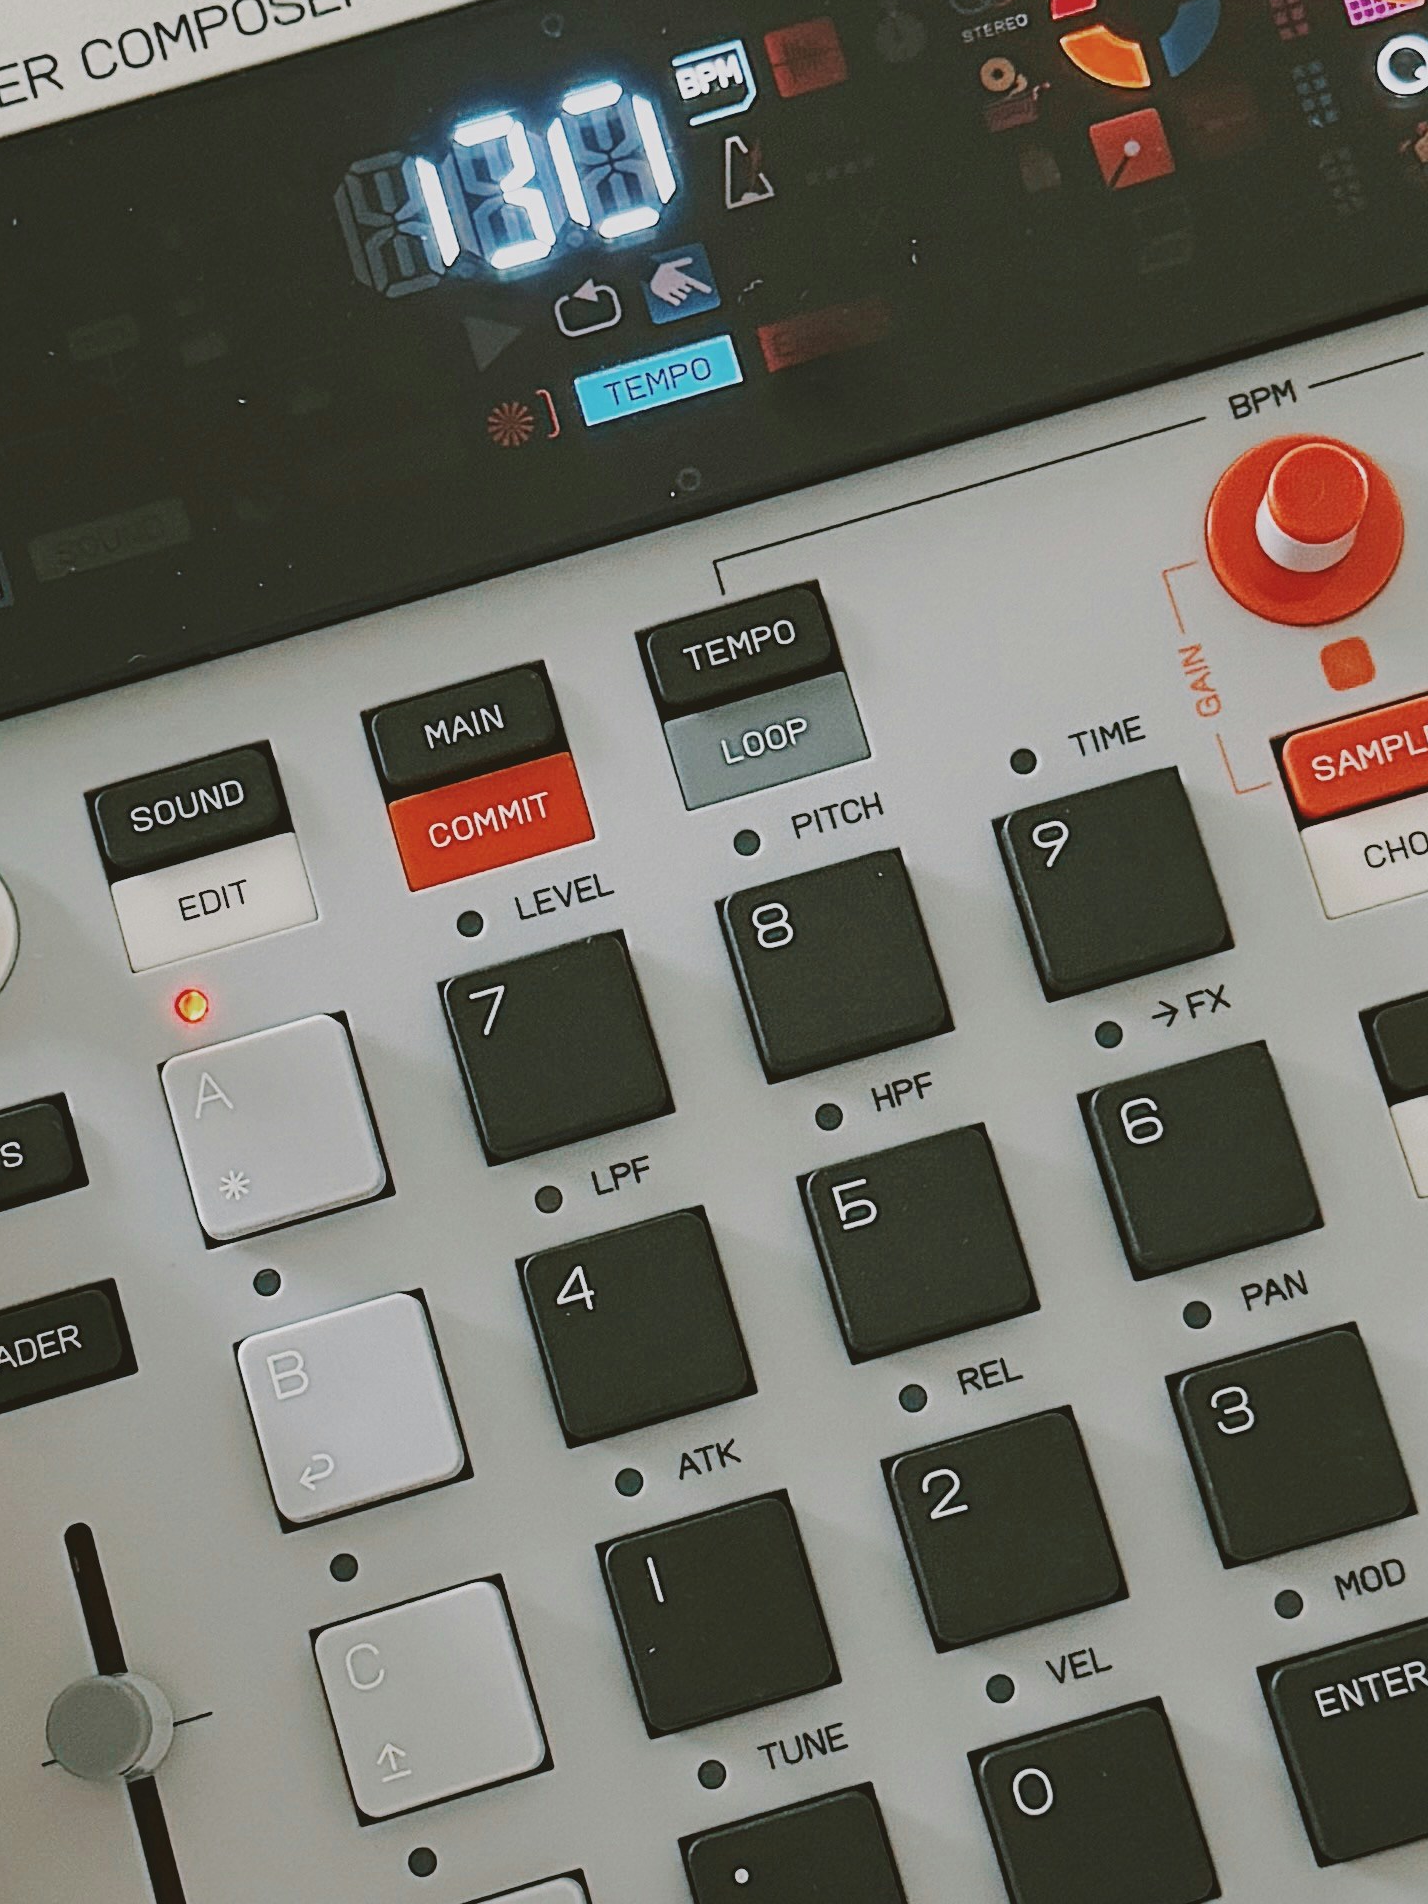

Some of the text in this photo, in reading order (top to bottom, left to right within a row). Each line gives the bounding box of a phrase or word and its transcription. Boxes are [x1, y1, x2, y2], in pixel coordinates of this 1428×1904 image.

[961, 13, 1029, 43] STEREO
[673, 52, 744, 102] BPM
[414, 79, 678, 271] 130
[603, 356, 713, 407] TEMPO
[1228, 378, 1298, 421] BPM
[681, 618, 797, 673] TEMPO
[1178, 643, 1223, 718] GAIN
[423, 704, 505, 750] MAIN
[720, 716, 808, 766] LOOP
[1067, 715, 1147, 760] TIME
[129, 778, 245, 834] SOUND
[427, 791, 550, 850] COMMIT
[790, 791, 885, 840] PITCH
[1032, 819, 1070, 869] 9
[177, 878, 251, 922] EDIT
[514, 873, 616, 922] LEVEL
[749, 900, 794, 949] 8
[468, 983, 507, 1037] 7
[193, 1070, 235, 1120] A
[870, 1071, 934, 1113] HPF
[1120, 1096, 1165, 1146] 6
[590, 1155, 651, 1196] LPF
[830, 1177, 878, 1231] 5
[555, 1264, 596, 1311] 4
[1240, 1268, 1310, 1312] PAN
[265, 1348, 310, 1401] B
[956, 1356, 1024, 1396] REL
[1210, 1384, 1256, 1436] 3
[677, 1438, 743, 1481] ATK
[920, 1467, 969, 1520] 2
[1334, 1557, 1407, 1602] MOD
[344, 1642, 388, 1692] C
[1045, 1646, 1113, 1686] VEL
[756, 1721, 850, 1772] TUNE
[1011, 1766, 1055, 1816] 0
